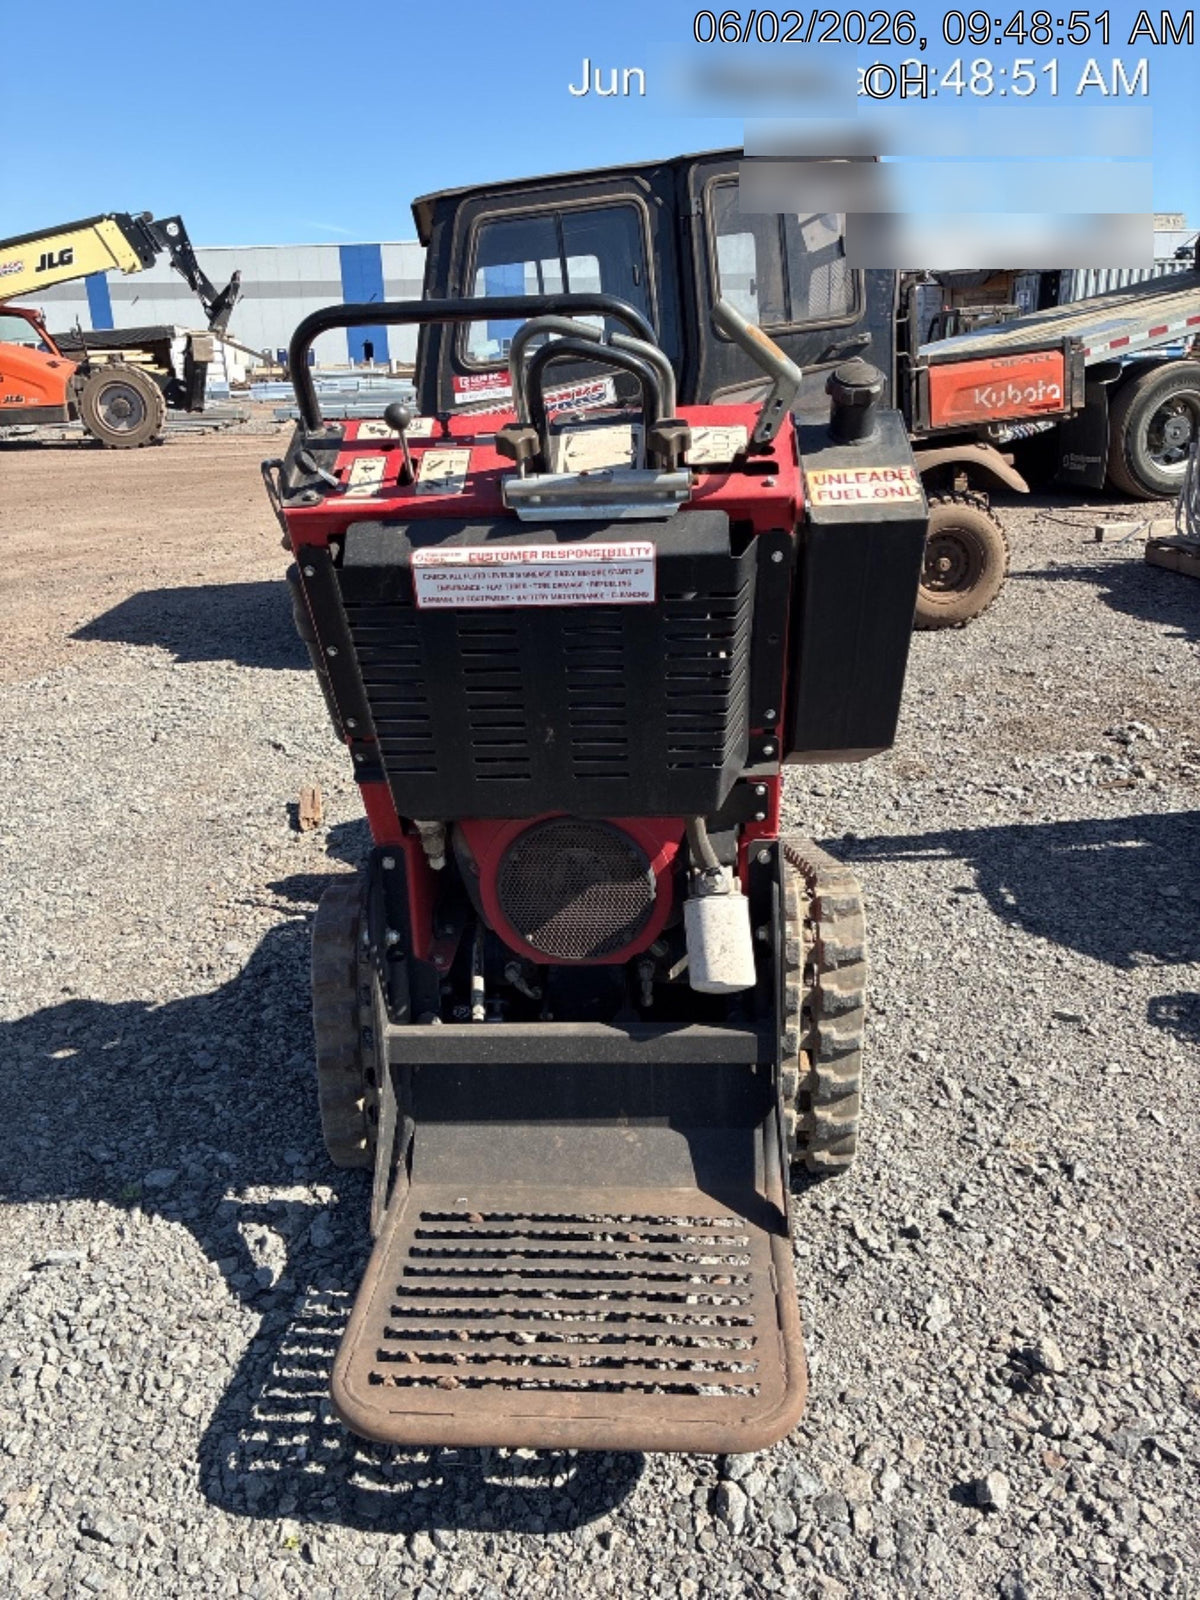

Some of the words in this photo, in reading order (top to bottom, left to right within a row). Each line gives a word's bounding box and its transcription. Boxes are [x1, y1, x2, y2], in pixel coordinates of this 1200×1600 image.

[35, 247, 73, 272] JLG
[974, 380, 1061, 409] Kubota
[817, 488, 867, 501] FUEL
[874, 485, 919, 498] ONL
[469, 550, 538, 563] CUSTOMER
[541, 547, 652, 560] RESPONSIBILITY
